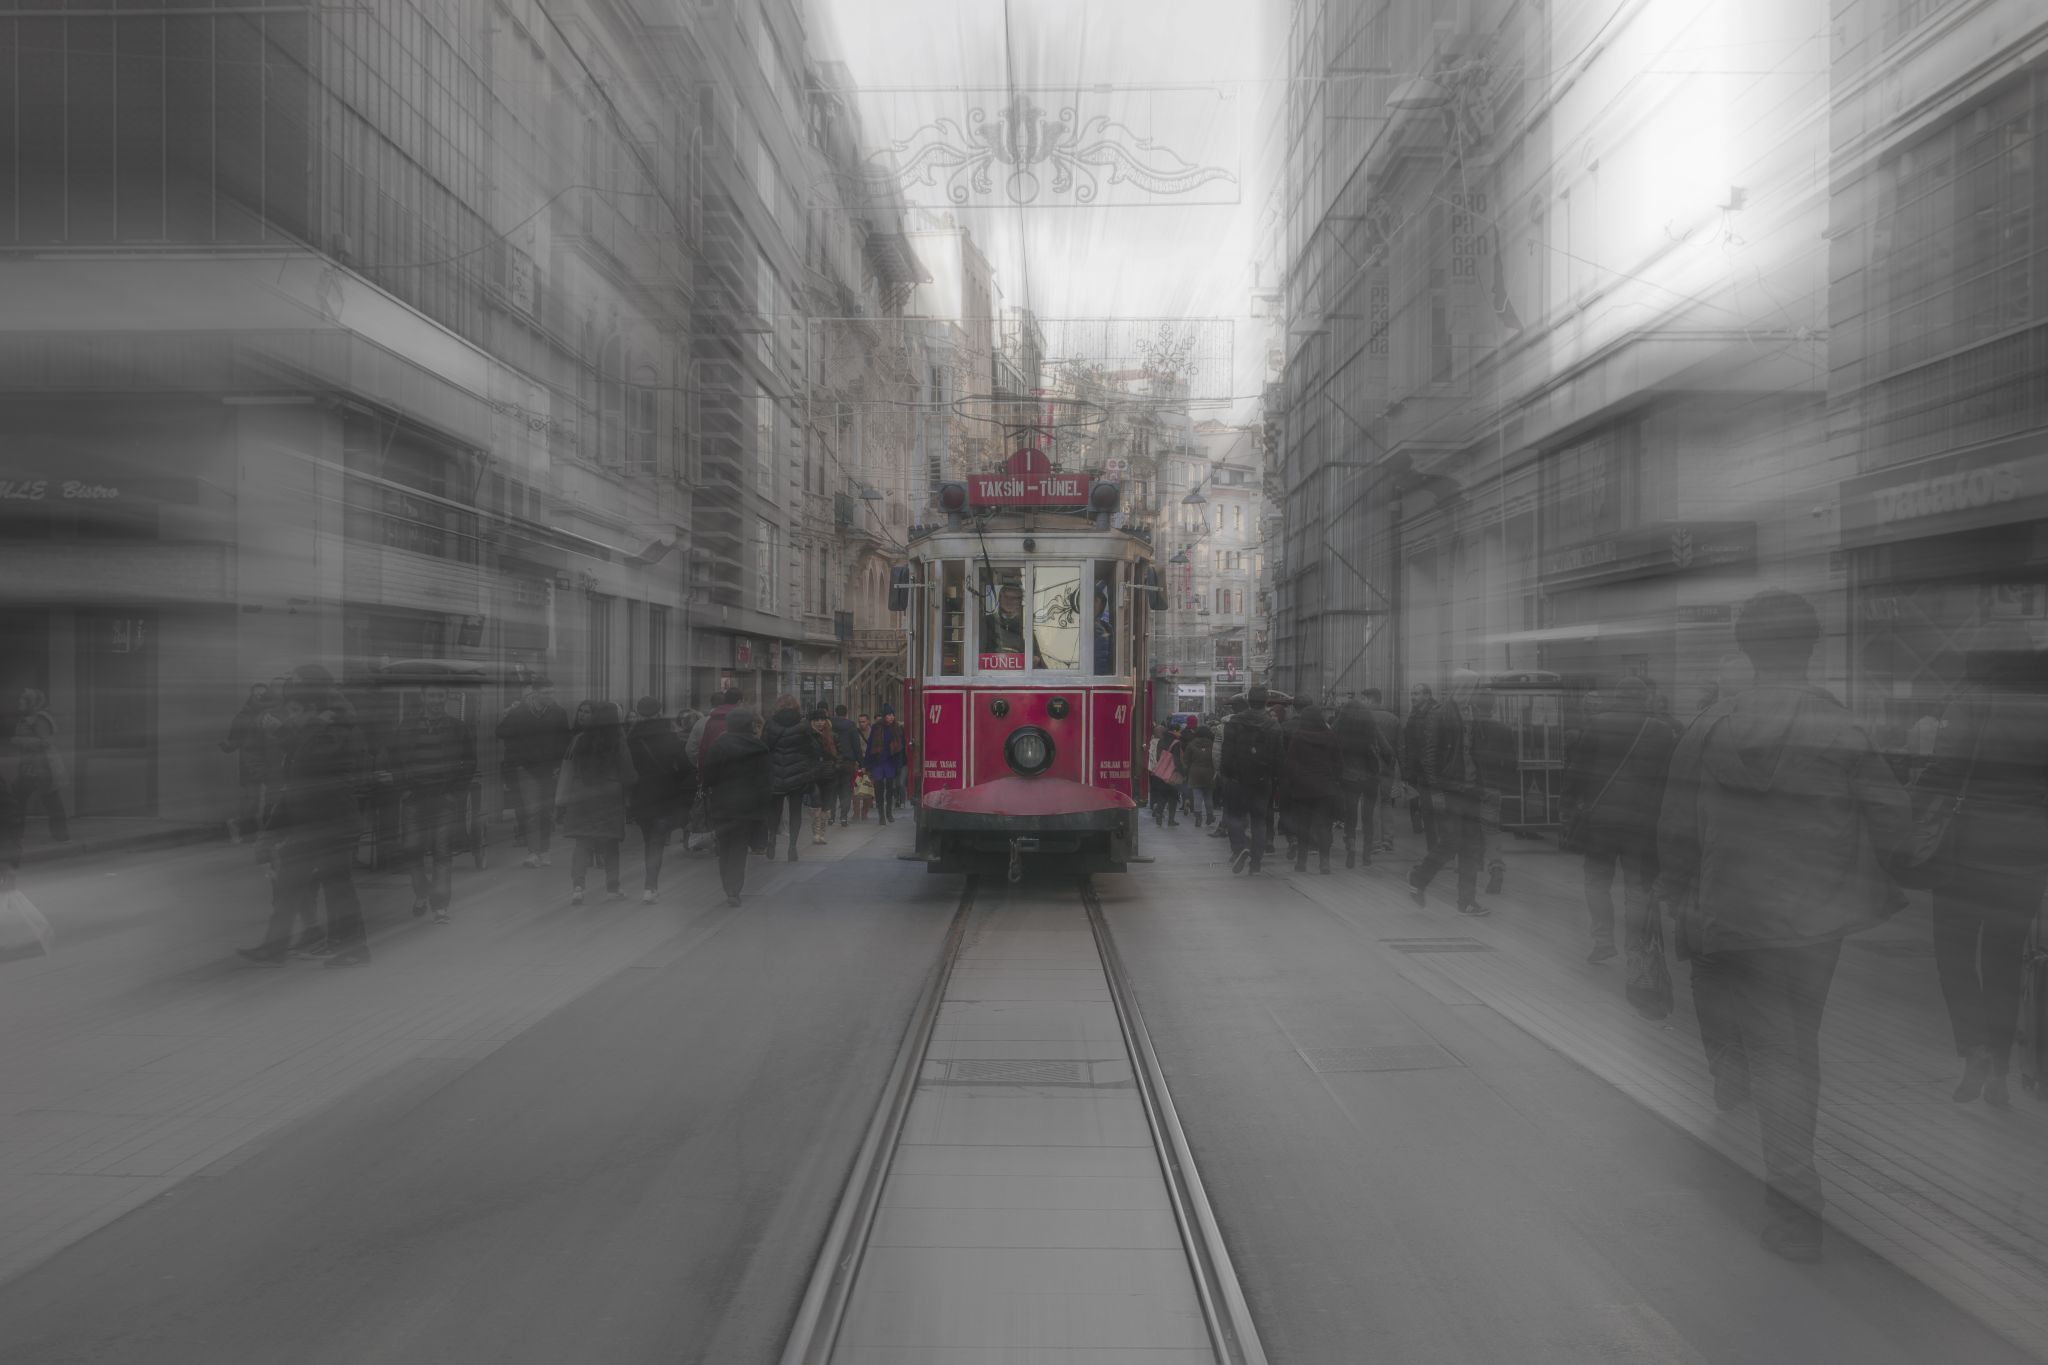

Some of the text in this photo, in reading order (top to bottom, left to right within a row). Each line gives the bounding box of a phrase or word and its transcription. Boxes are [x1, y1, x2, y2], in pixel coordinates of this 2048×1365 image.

[1026, 451, 1032, 471] 1
[62, 480, 120, 499] Bistro
[979, 477, 1024, 497] TAKSİM
[1040, 477, 1082, 497] TÜNEL
[982, 655, 1023, 669] TÜNEL
[929, 704, 942, 724] 47
[1114, 704, 1127, 725] 47
